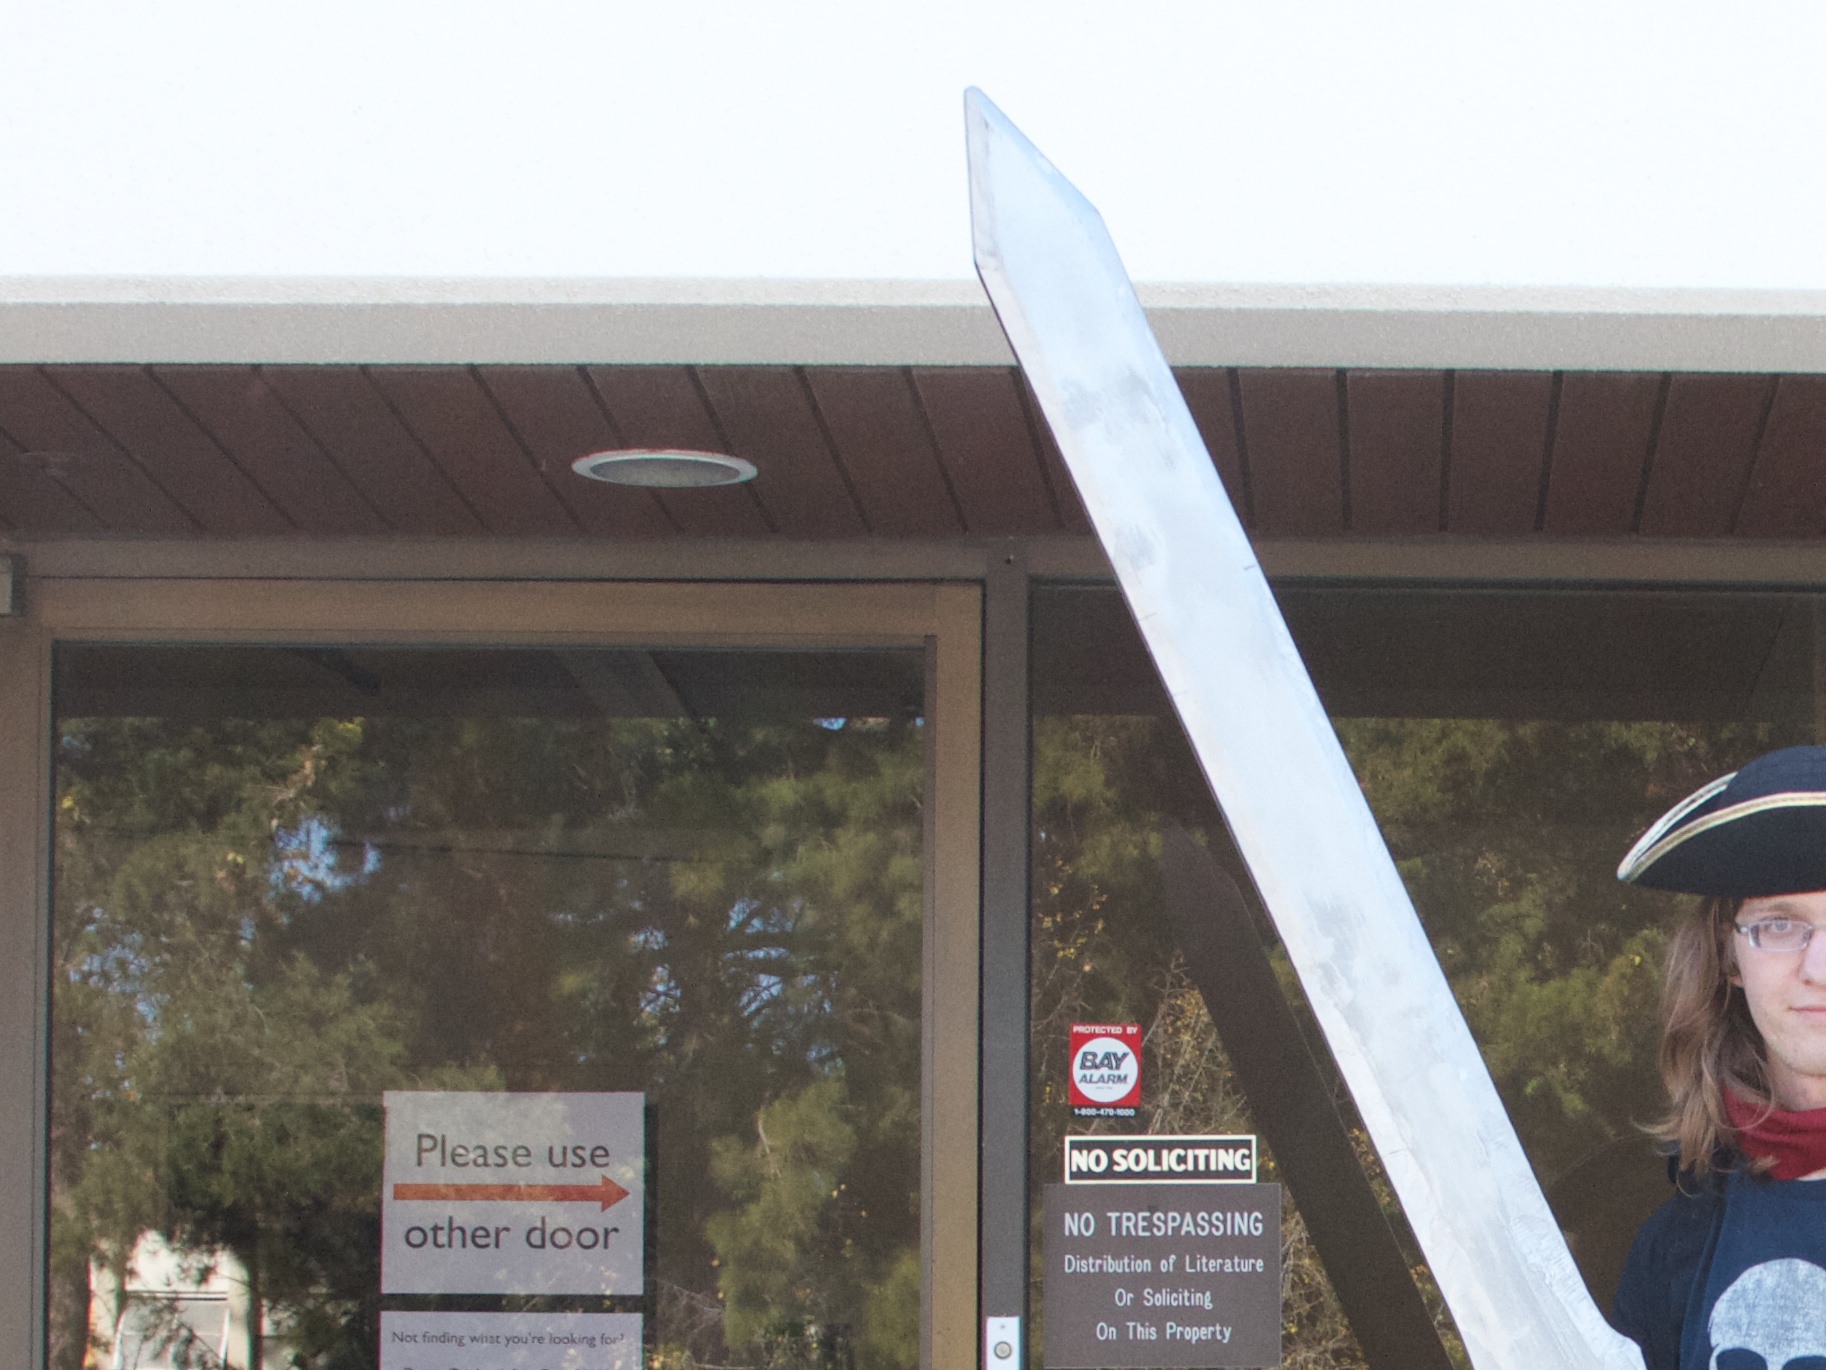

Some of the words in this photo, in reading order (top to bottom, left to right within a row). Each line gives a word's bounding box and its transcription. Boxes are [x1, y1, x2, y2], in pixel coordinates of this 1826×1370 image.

[1073, 1025, 1123, 1034] PROTECTED
[1126, 1026, 1138, 1035] BY
[1080, 1051, 1130, 1071] BAY
[1079, 1073, 1128, 1085] ALARM
[416, 1133, 532, 1168] Please
[548, 1144, 610, 1168] use
[1071, 1149, 1109, 1173] NO
[1112, 1148, 1251, 1173] SOLICITING
[405, 1216, 511, 1249] other
[525, 1216, 620, 1250] door
[1064, 1212, 1095, 1237] NO
[1106, 1211, 1264, 1237] TRESPASSING
[1064, 1254, 1151, 1273] Distribution
[1160, 1255, 1177, 1273] of
[1185, 1255, 1265, 1273] Literature
[1115, 1288, 1135, 1307] Or
[1143, 1288, 1214, 1310] Soliciting
[392, 1332, 419, 1343] Not
[422, 1331, 465, 1347] finding
[469, 1332, 502, 1344] what
[504, 1333, 545, 1348] you're
[548, 1333, 597, 1349] looking
[1096, 1322, 1117, 1341] On
[1126, 1322, 1158, 1341] This
[1166, 1322, 1232, 1344] Property
